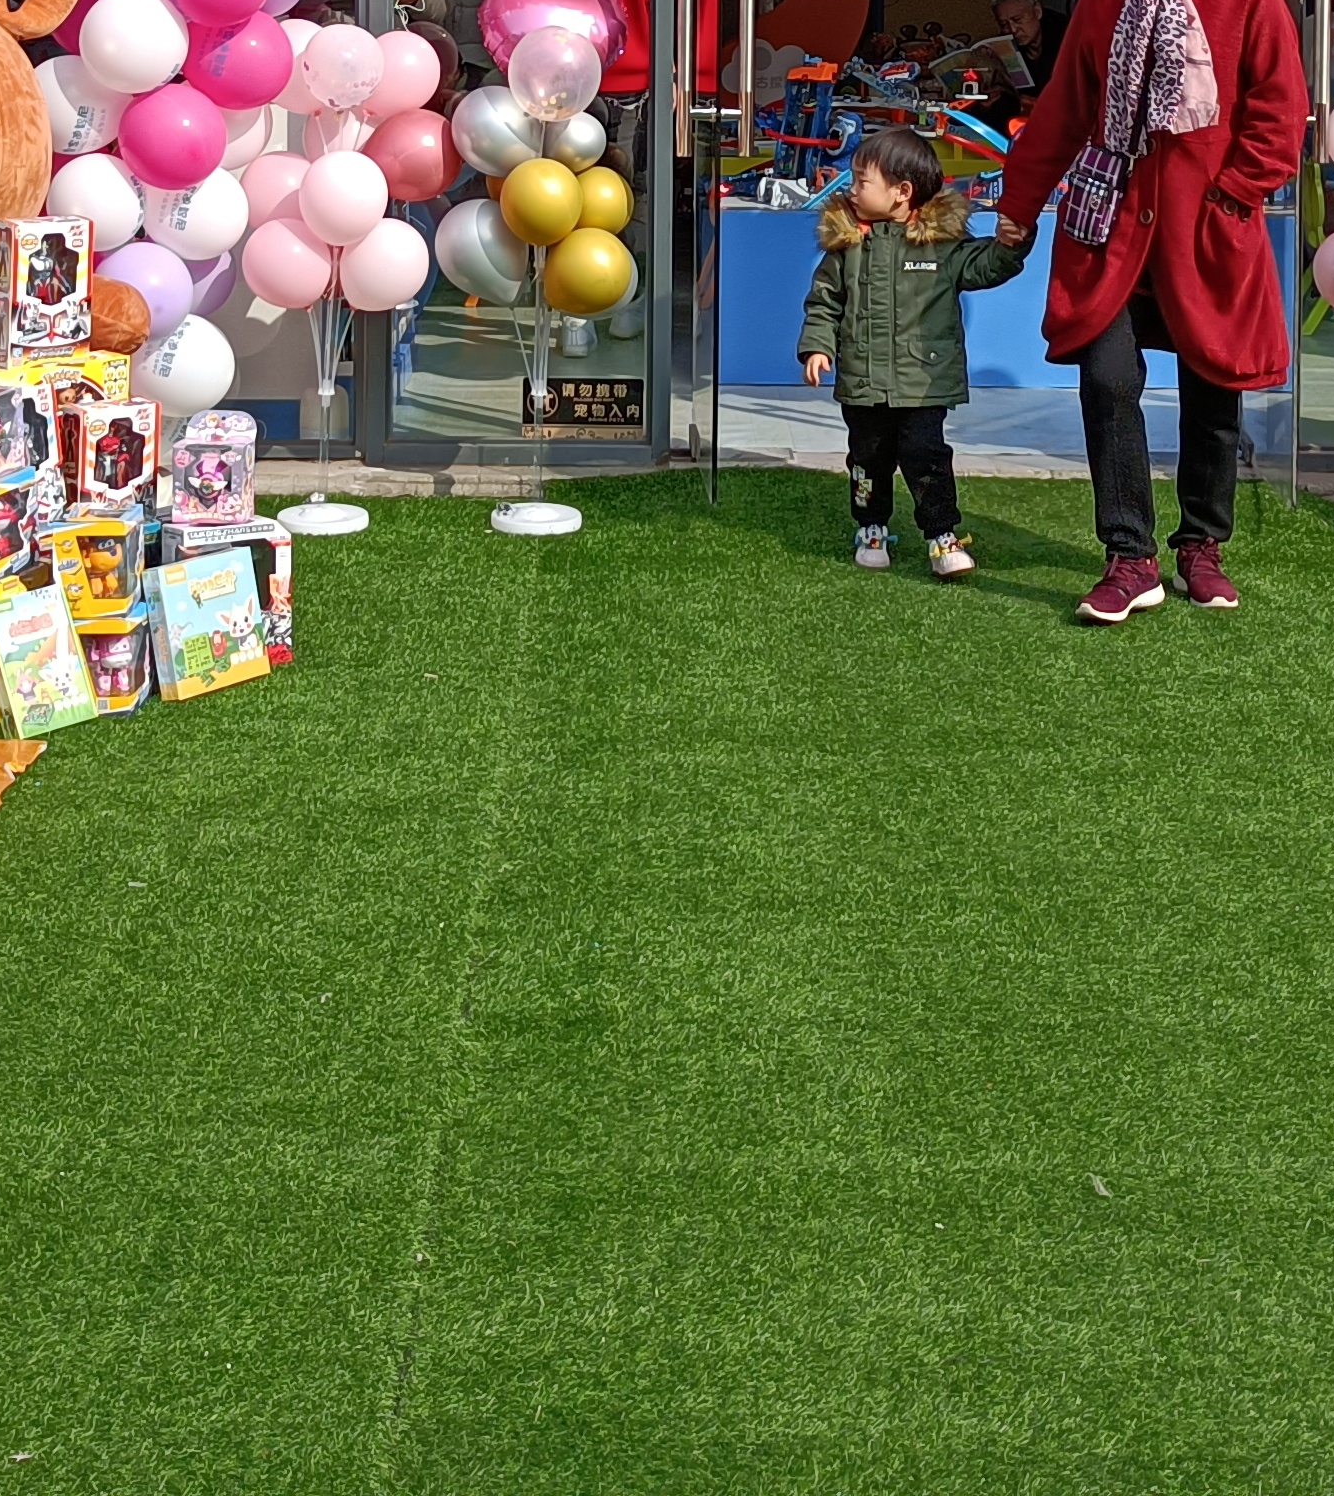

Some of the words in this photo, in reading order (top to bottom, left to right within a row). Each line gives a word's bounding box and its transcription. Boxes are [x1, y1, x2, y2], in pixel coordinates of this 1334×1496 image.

[562, 383, 627, 398] 请勿携带
[574, 404, 640, 418] 宠物入内
